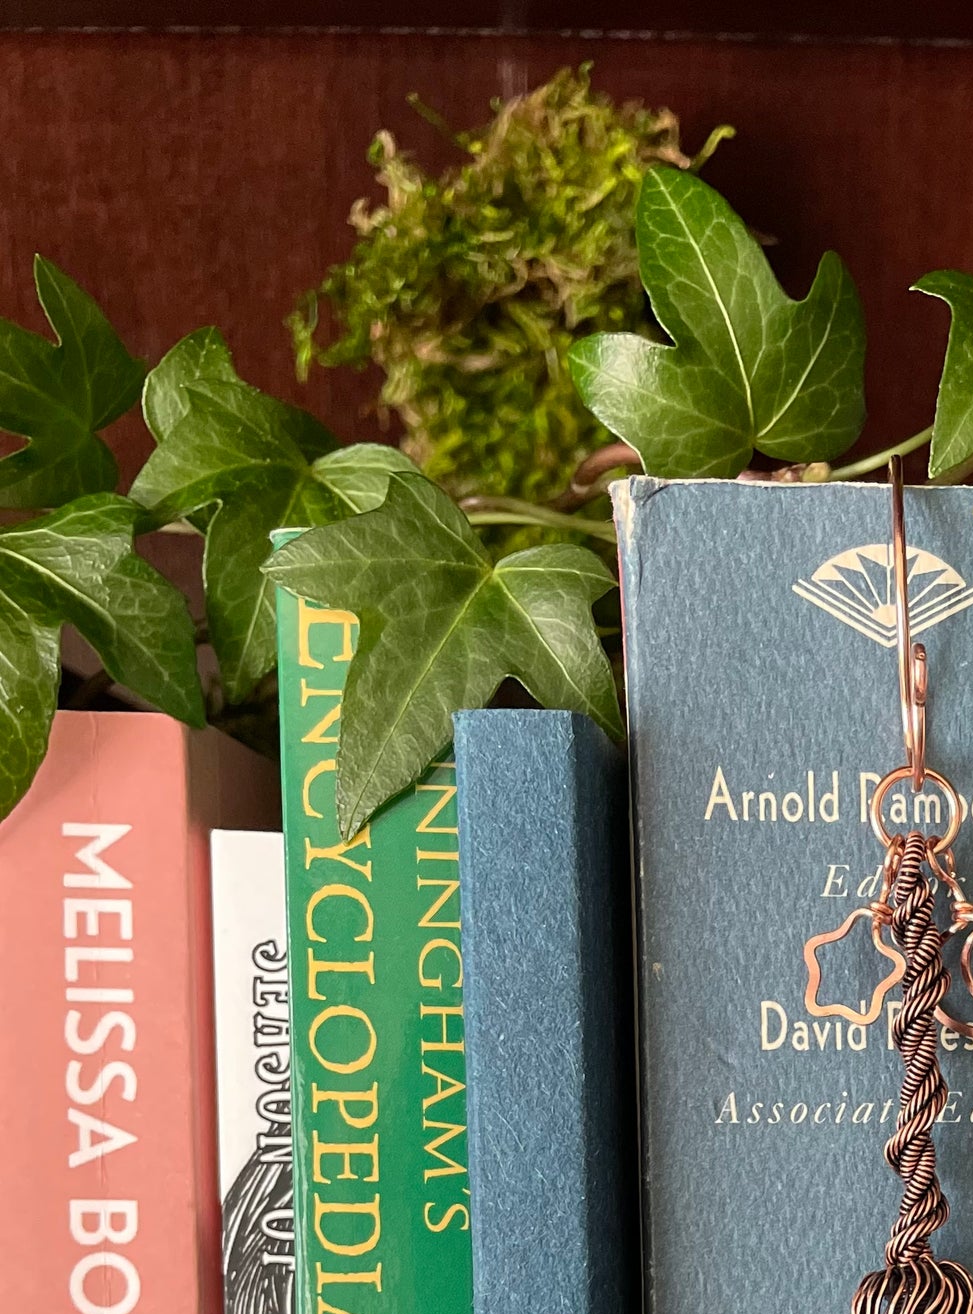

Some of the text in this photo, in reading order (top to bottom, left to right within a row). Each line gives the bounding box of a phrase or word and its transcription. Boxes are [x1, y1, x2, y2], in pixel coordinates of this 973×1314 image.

[704, 765, 839, 823] Arnold
[62, 823, 138, 1168] MELISSA
[761, 999, 868, 1051] David
[714, 1090, 906, 1125] Associat
